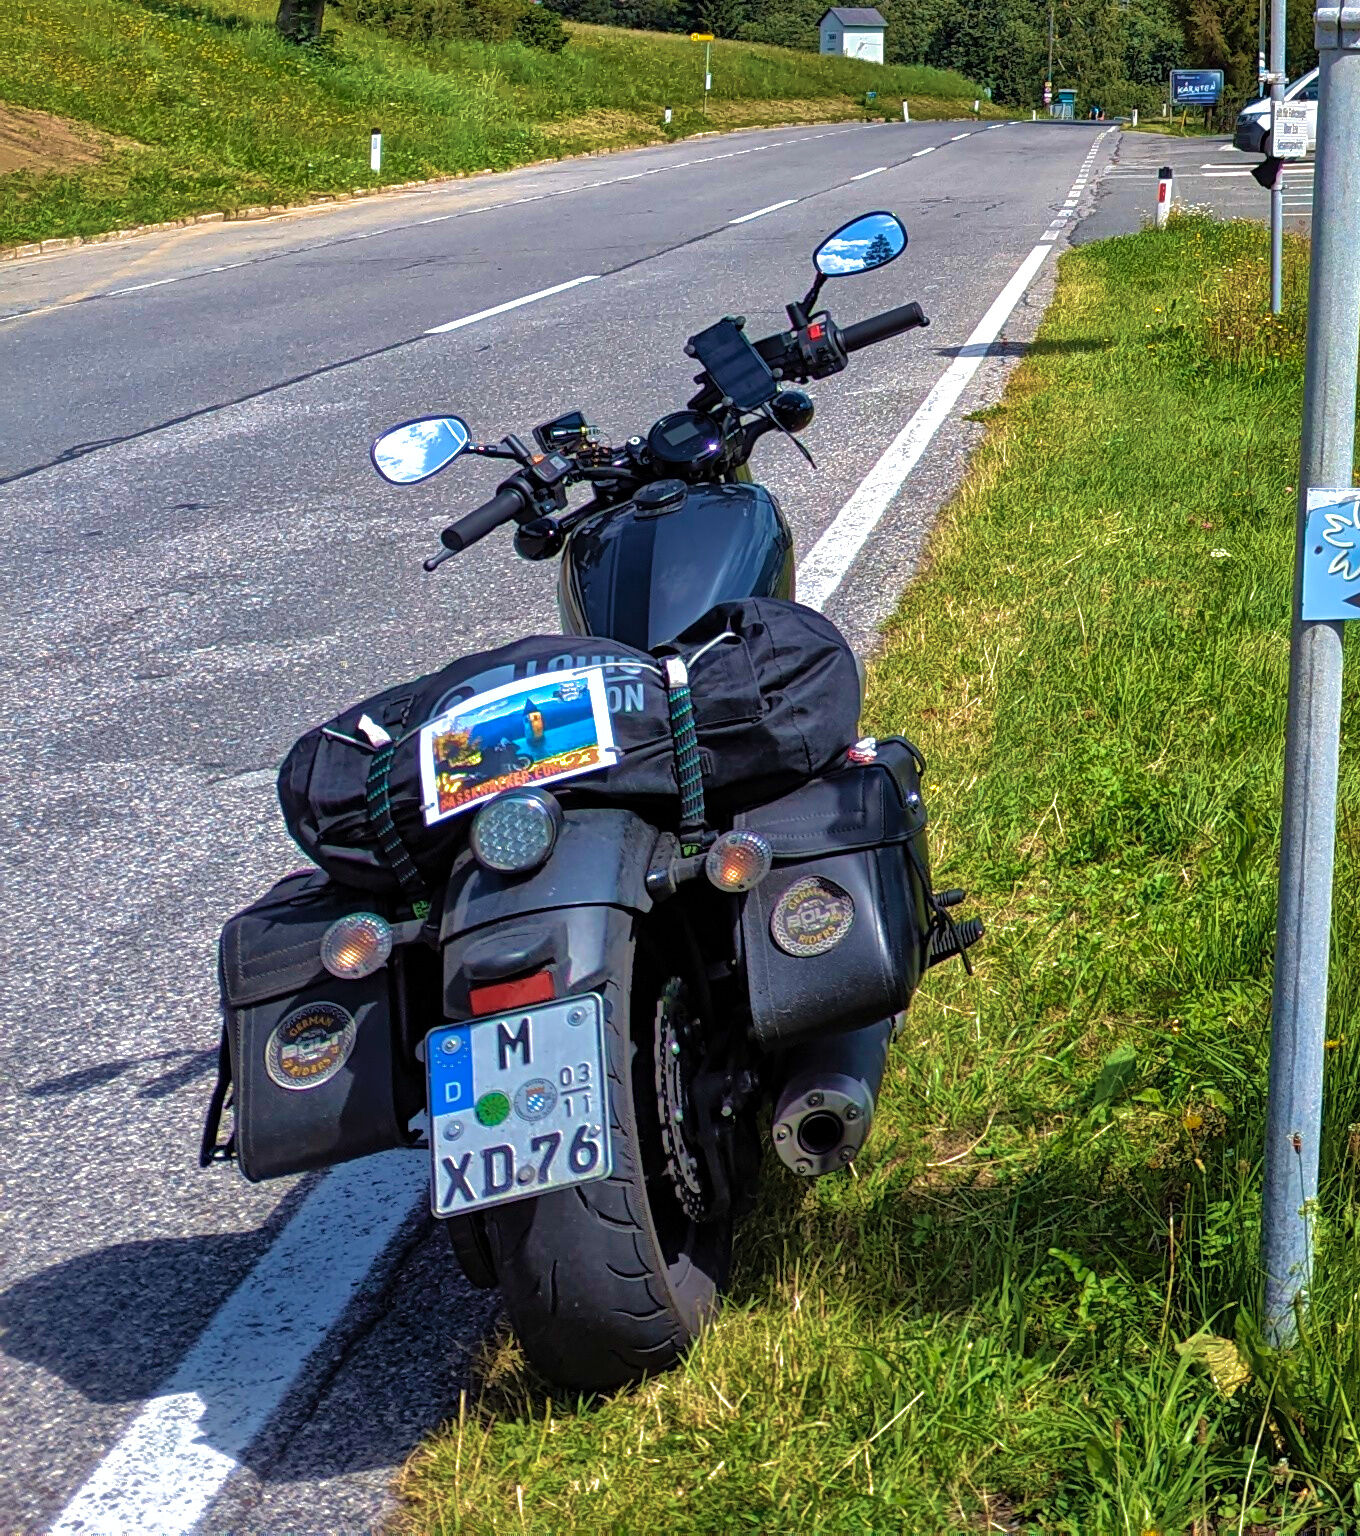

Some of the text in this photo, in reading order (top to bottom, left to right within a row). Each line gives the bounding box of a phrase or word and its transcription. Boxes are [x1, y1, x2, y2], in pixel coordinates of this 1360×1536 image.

[497, 1016, 533, 1071] M
[445, 1081, 462, 1104] D
[559, 1063, 592, 1087] 03
[441, 1123, 600, 1209] XD 76
